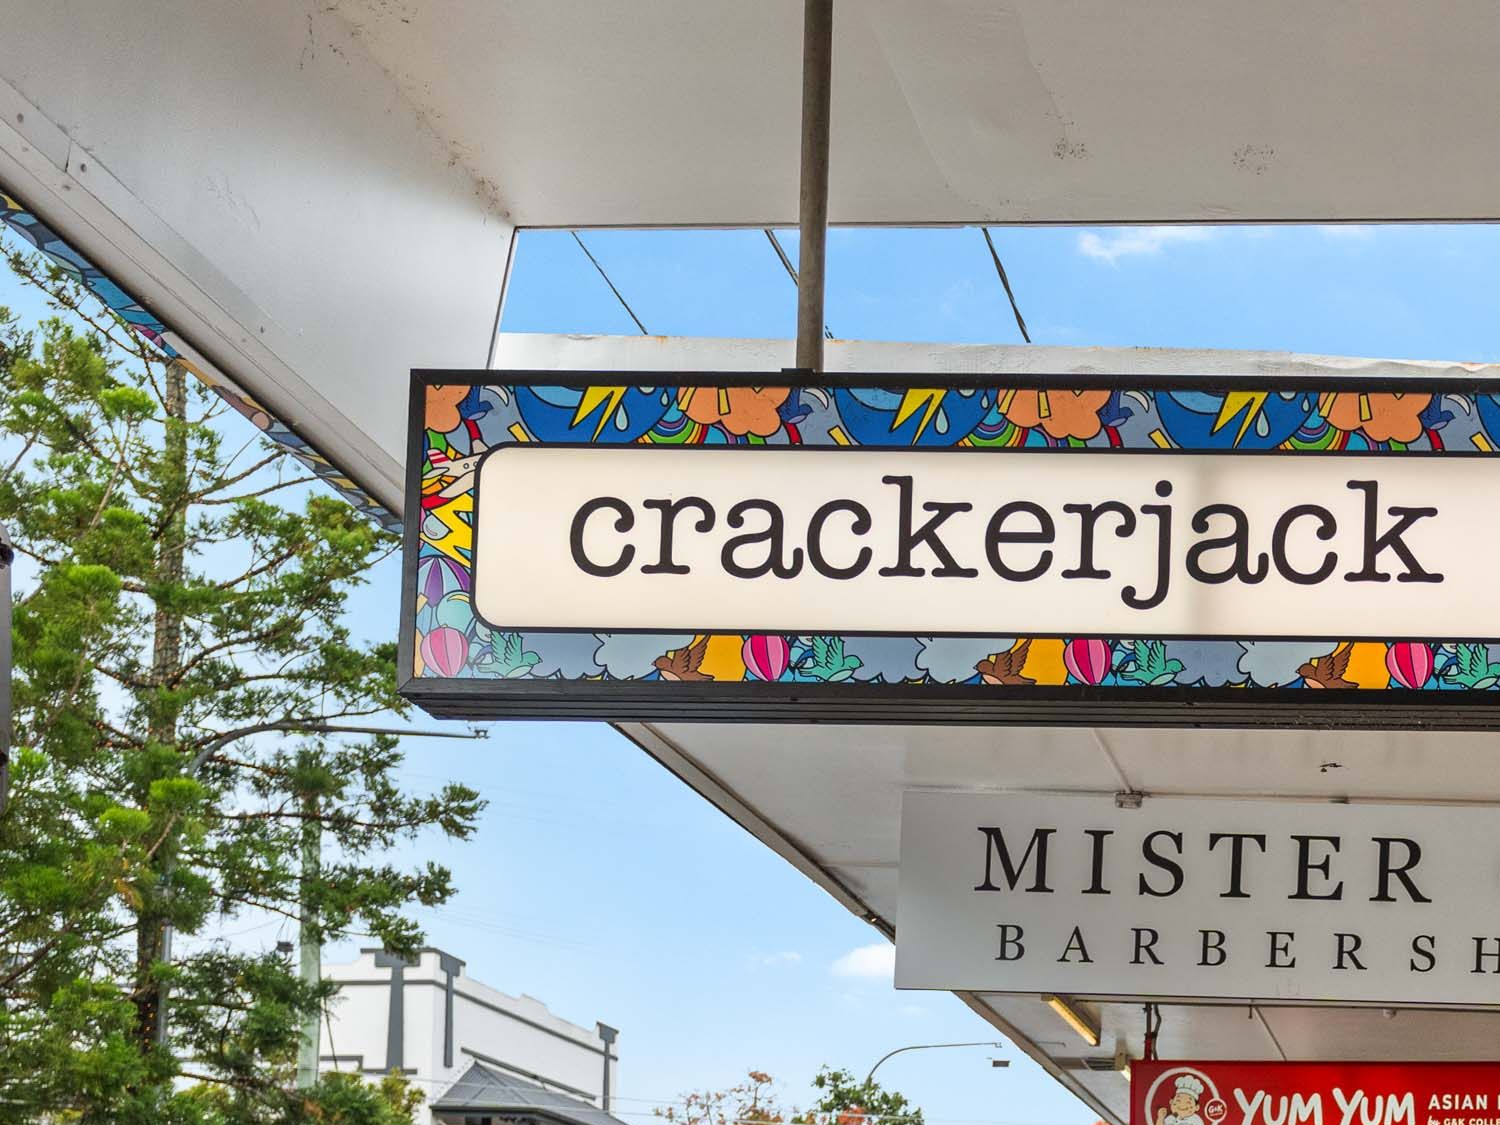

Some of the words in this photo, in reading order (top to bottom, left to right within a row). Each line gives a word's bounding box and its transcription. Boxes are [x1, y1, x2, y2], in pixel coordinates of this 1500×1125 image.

[569, 475, 1444, 609] crackerjack
[974, 826, 1432, 904] MISTER
[1428, 1093, 1491, 1111] ASIAN
